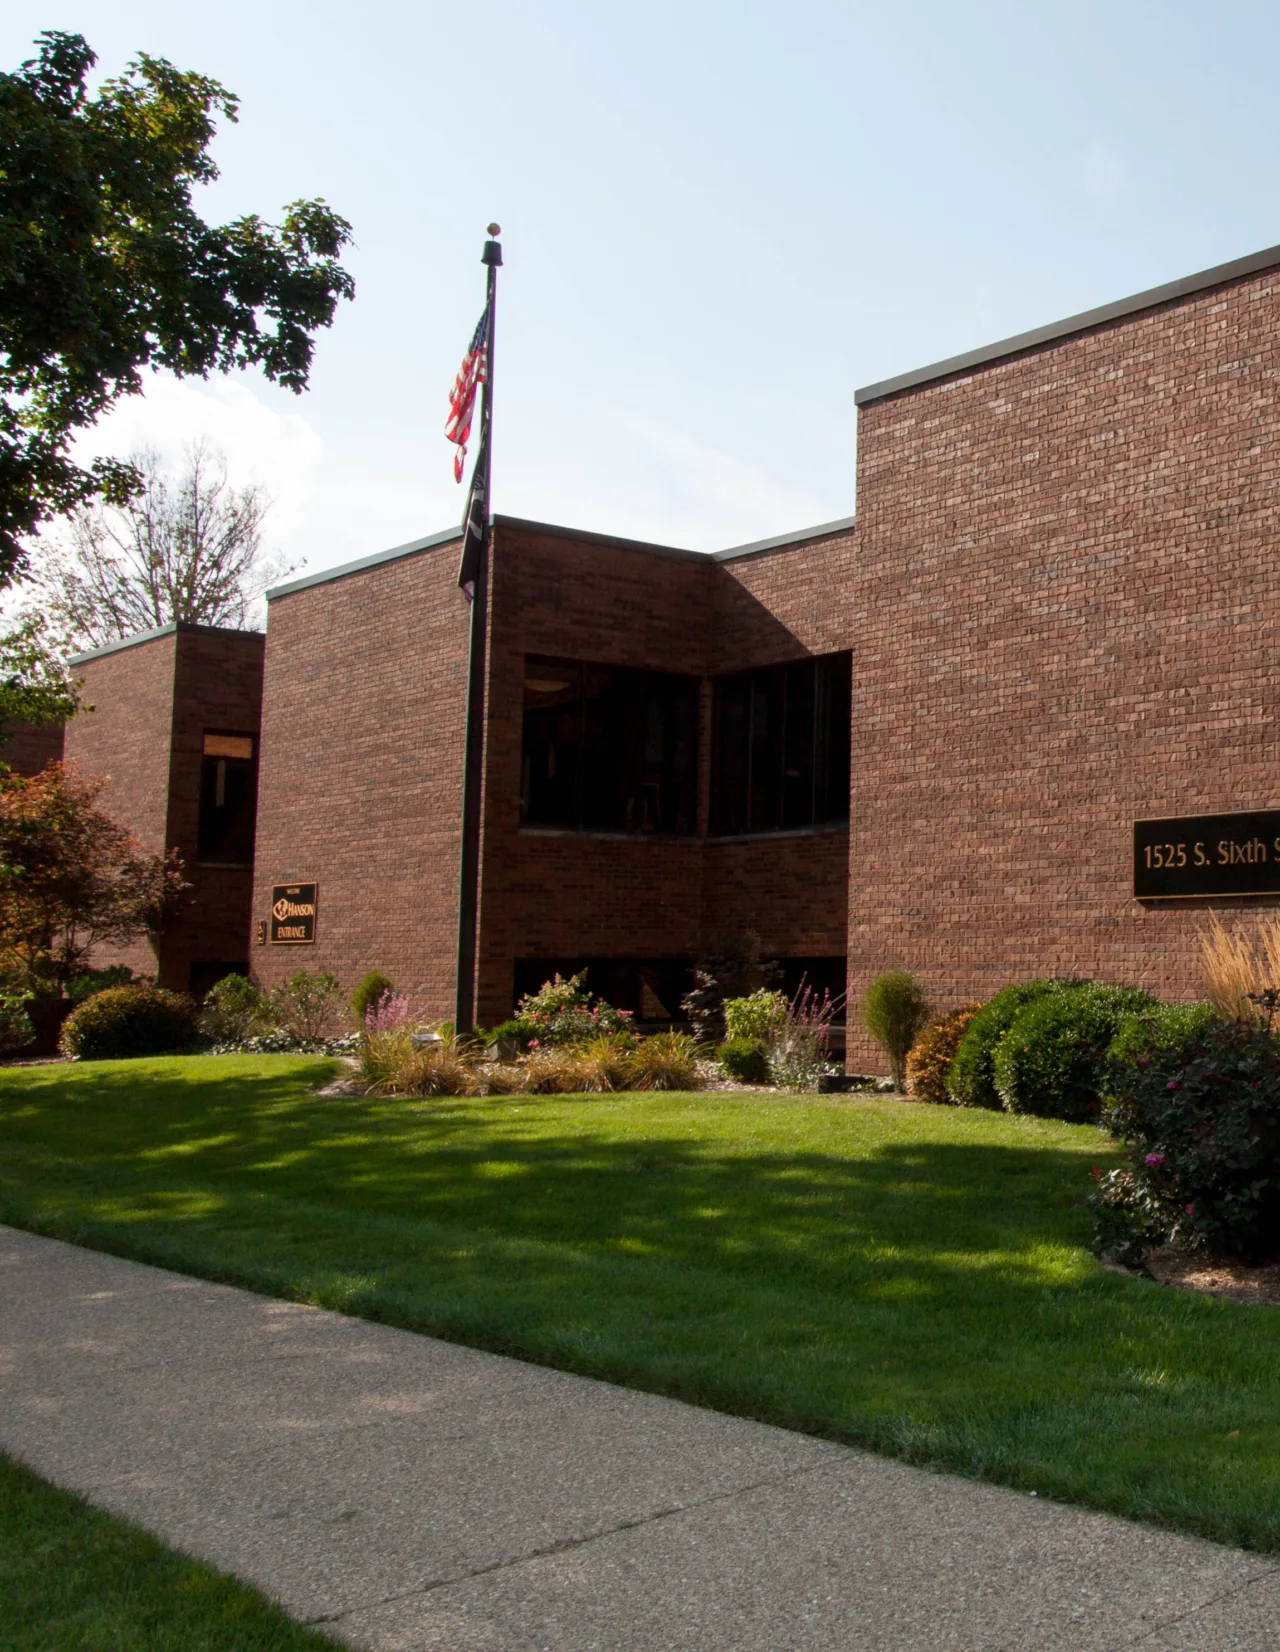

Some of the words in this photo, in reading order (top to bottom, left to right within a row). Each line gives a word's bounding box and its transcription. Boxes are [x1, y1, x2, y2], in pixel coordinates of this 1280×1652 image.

[1144, 844, 1187, 869] 1525
[1194, 842, 1210, 866] S.
[1218, 837, 1267, 865] Sixth
[288, 902, 314, 916] HANSON
[277, 926, 306, 938] ENTRANCE
